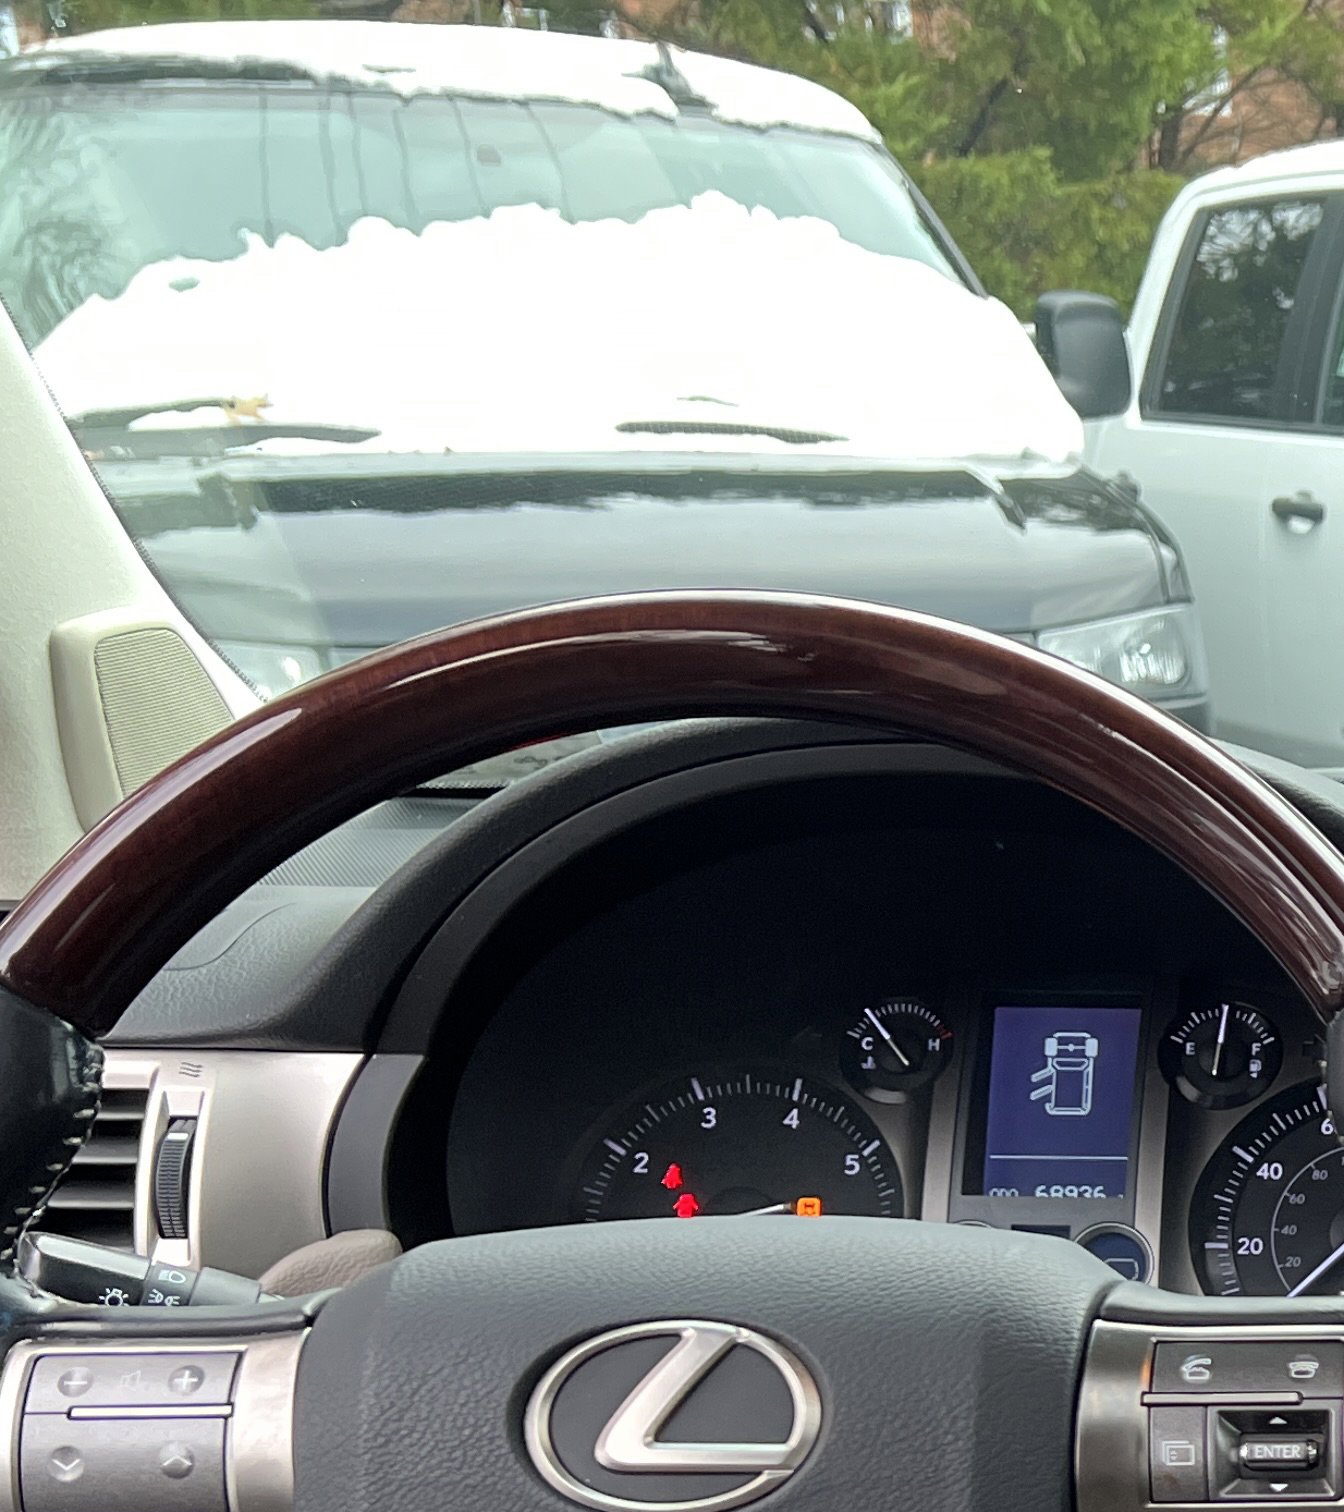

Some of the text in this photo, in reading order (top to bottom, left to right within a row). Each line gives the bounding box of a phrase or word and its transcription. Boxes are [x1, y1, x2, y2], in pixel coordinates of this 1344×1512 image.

[700, 1106, 718, 1129] 3
[782, 1108, 801, 1130] 4
[632, 1152, 650, 1175] 2
[843, 1154, 861, 1176] 5
[1255, 1162, 1284, 1181] 40
[1237, 1237, 1264, 1256] 20
[1254, 1443, 1301, 1460] ENTER
